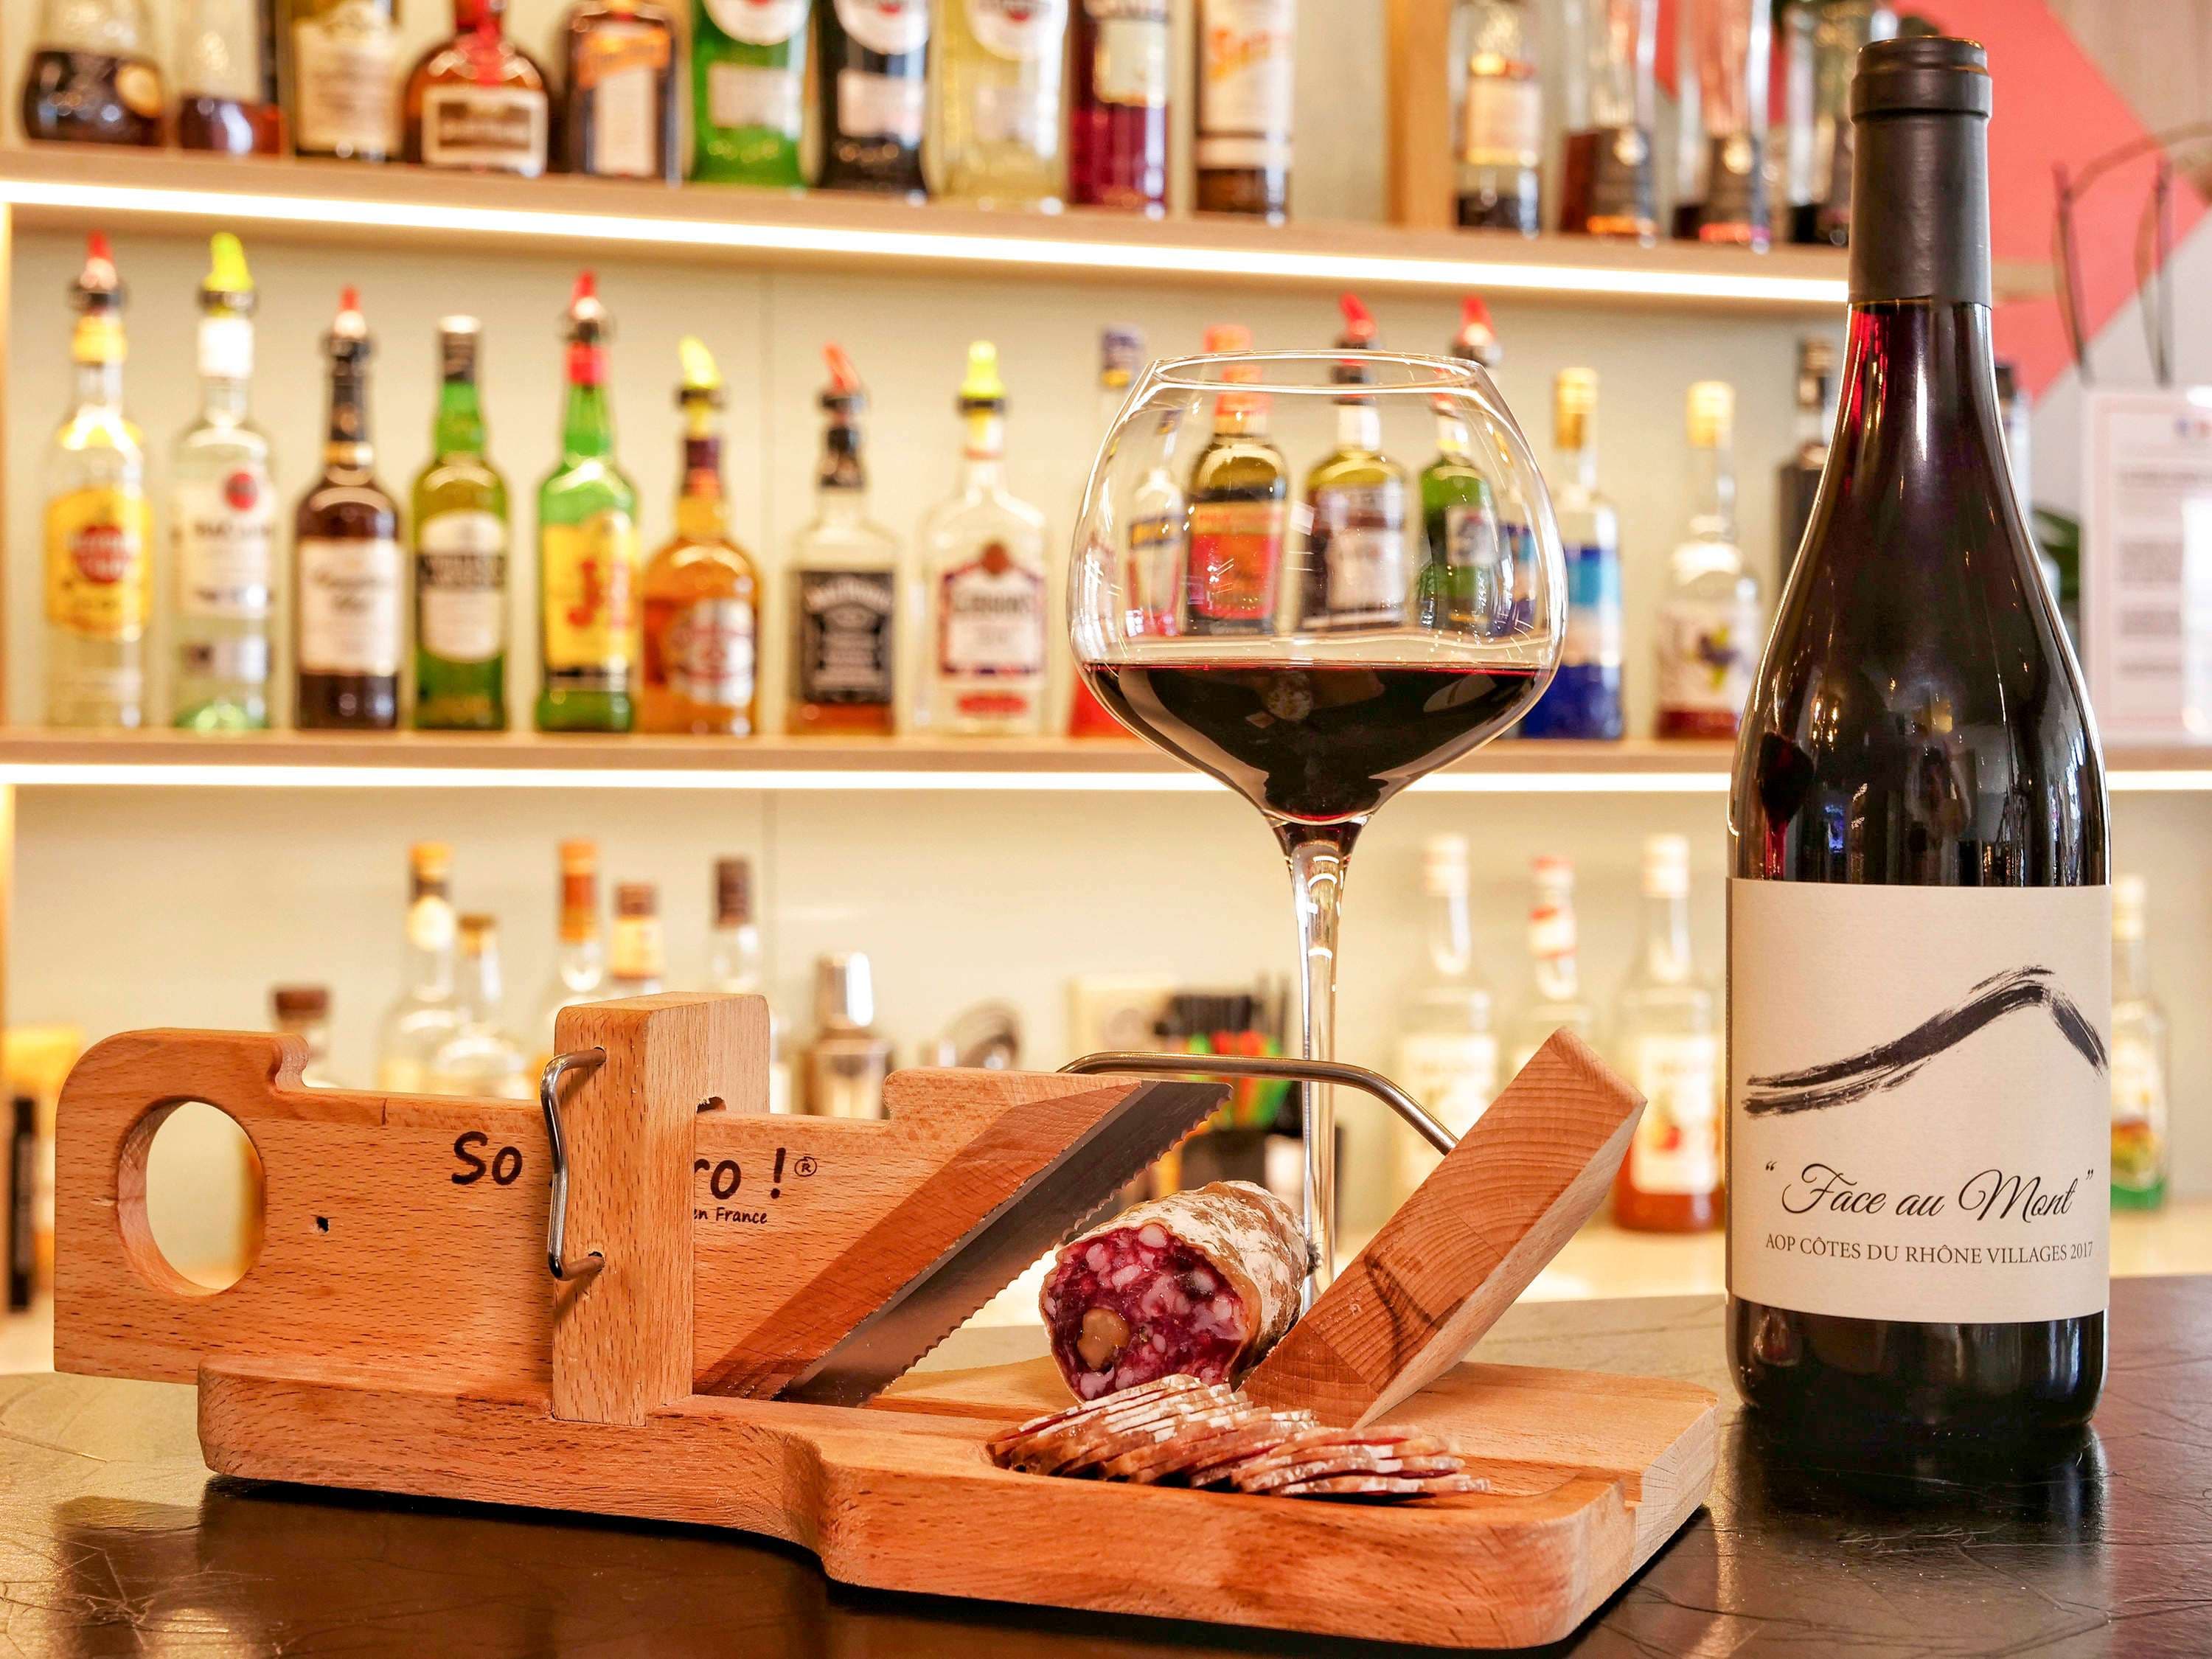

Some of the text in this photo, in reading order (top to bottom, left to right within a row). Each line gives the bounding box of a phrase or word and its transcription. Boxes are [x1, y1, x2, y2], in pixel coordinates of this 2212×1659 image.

[451, 1131, 523, 1186] So
[715, 1206, 768, 1224] France
[1895, 1194, 1945, 1217] au
[1765, 1233, 2093, 1264] AOP CÔTES DU RHÔNE VILLAGES 2017
